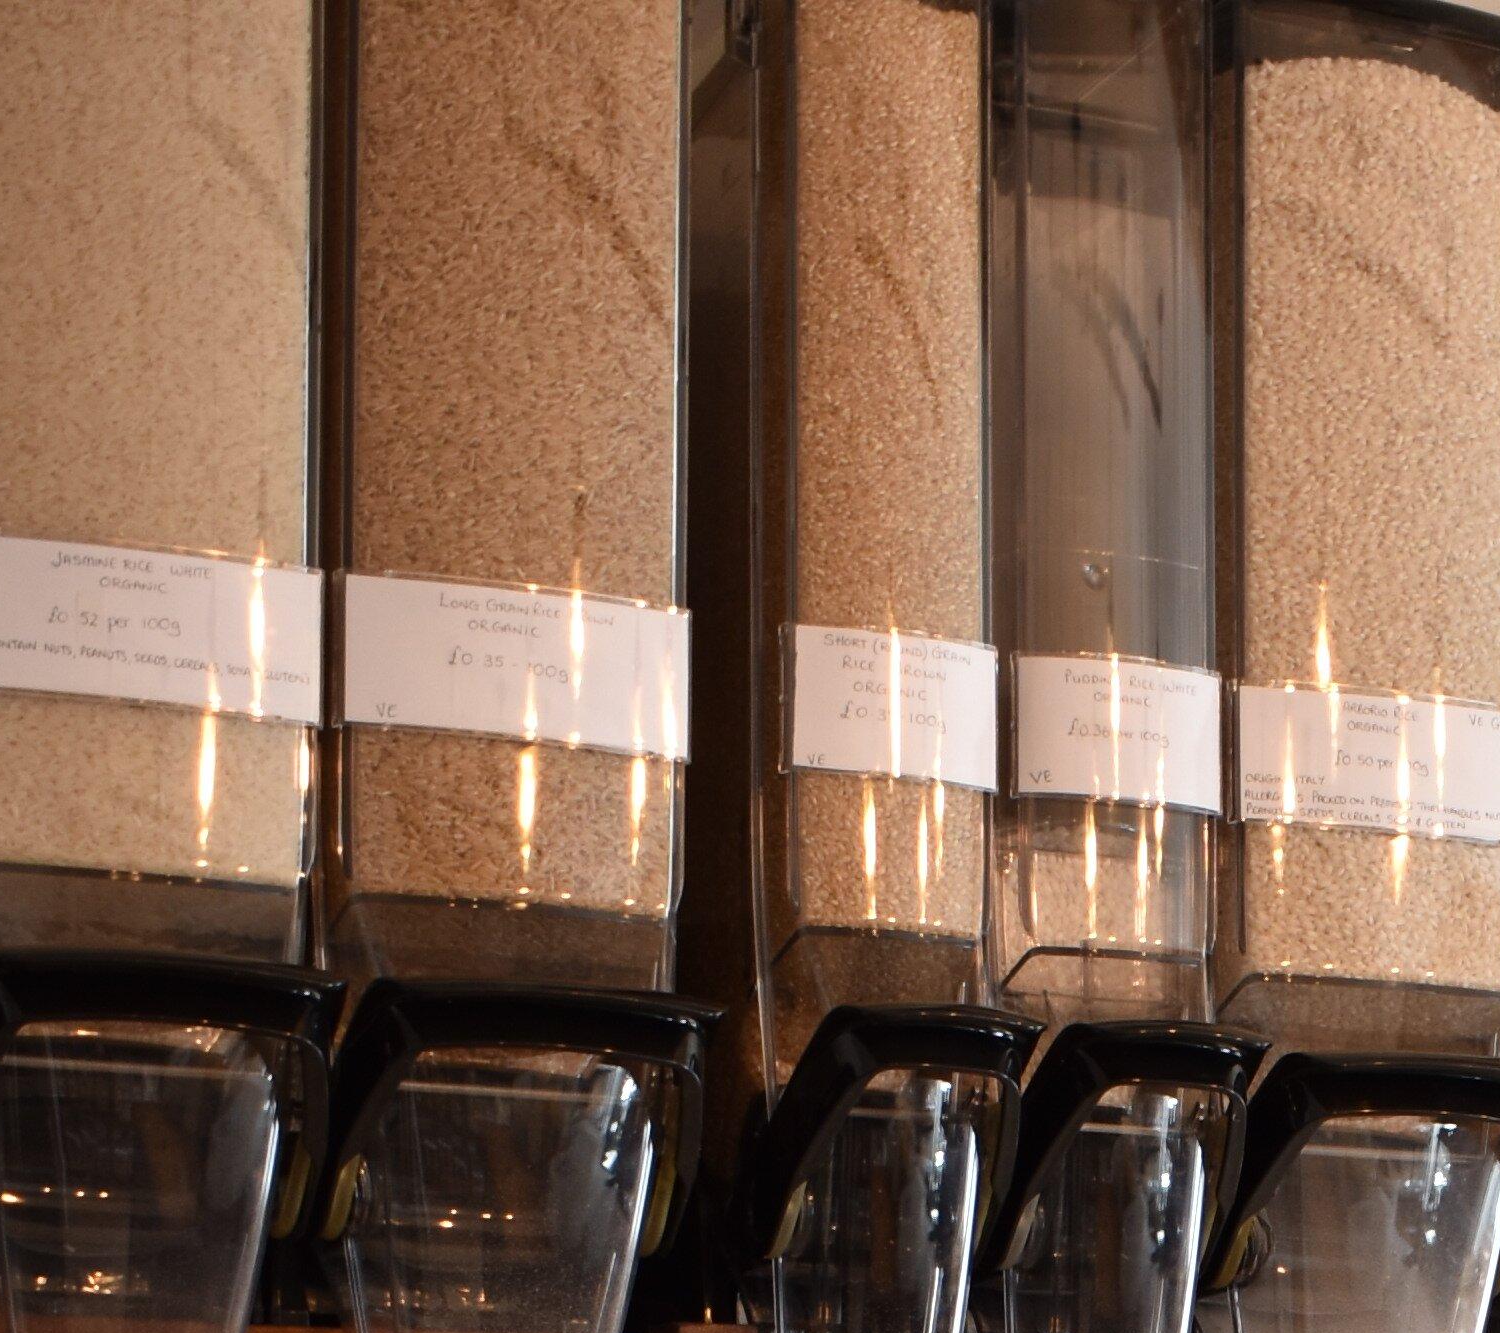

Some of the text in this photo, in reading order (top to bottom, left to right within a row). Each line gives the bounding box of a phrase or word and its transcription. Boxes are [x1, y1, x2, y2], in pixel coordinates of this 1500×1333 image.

[49, 551, 117, 573] JASMINE
[98, 575, 167, 595] ORGANIC
[467, 618, 540, 639] ORGANIC
[852, 681, 928, 702] ORGNIC
